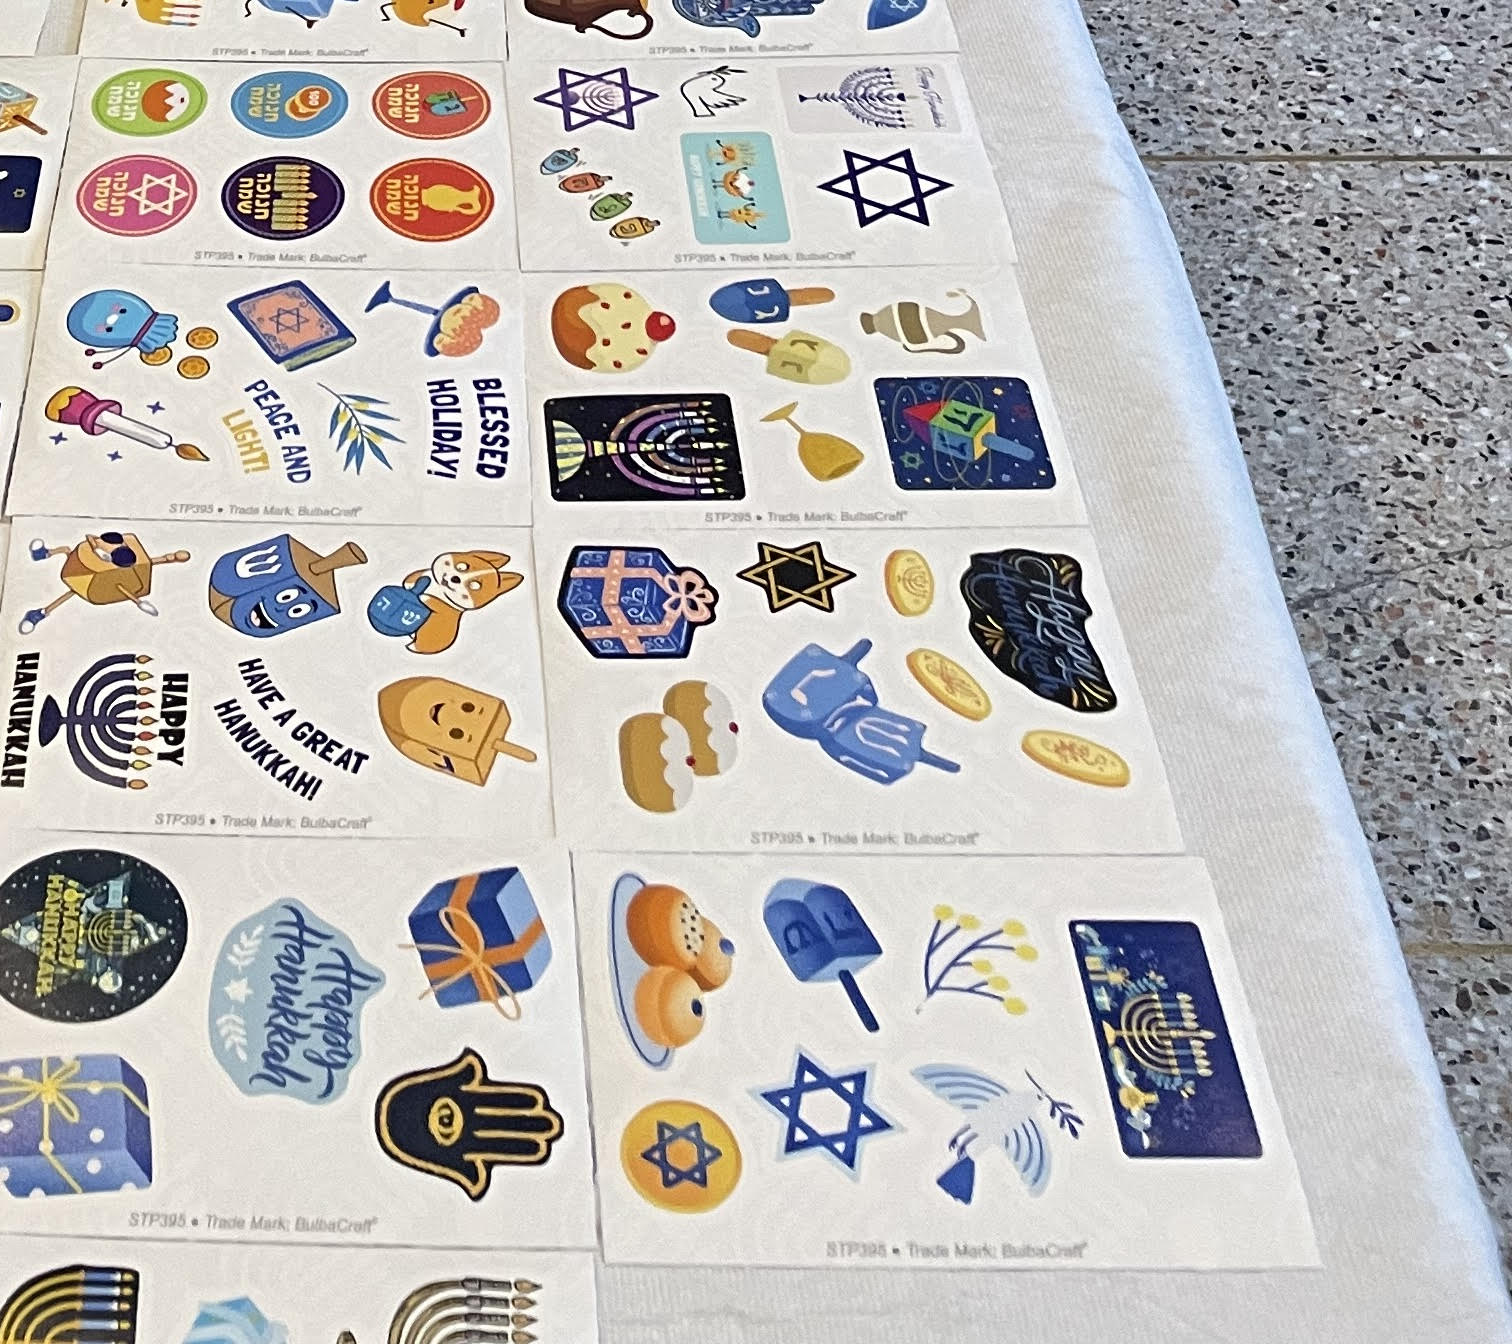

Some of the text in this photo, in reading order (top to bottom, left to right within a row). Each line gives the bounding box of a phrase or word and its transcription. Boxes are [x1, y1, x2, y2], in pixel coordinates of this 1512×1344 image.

[107, 85, 124, 118] שמח
[123, 81, 142, 122] חנוכה
[248, 86, 265, 118] שמח
[264, 82, 282, 123] חנוכה
[388, 87, 403, 119] שמח
[404, 83, 419, 123] חנוכה
[93, 176, 111, 212] שמח
[109, 171, 129, 217] חנוכה
[237, 177, 254, 215] שמח
[254, 173, 272, 220] חנוכה
[386, 178, 401, 215] שמח
[403, 174, 419, 222] חנוכה
[222, 409, 269, 473] LIGHT!
[245, 379, 311, 483] PEACE AND
[427, 379, 462, 479] HOLIDAY!
[473, 378, 510, 479] BLESSED
[229, 505, 260, 516] Trade
[767, 512, 800, 523] Trade
[1014, 555, 1102, 682] Happy
[0, 652, 40, 787] HANUKKAH
[157, 673, 188, 766] HAPPY
[239, 658, 369, 774] HAVE A GREAT
[214, 698, 323, 801] HANUKKAH!
[154, 813, 206, 827] STP395
[222, 815, 257, 828] Trade
[750, 831, 804, 846] STP395
[820, 831, 858, 846] Trade
[35, 874, 65, 998] HANUKKAH
[57, 906, 81, 970] HAPPY
[249, 905, 334, 1089] Hanukkah
[303, 948, 381, 1100] Happy
[127, 1212, 186, 1229] STP395
[205, 1214, 246, 1231] Trade
[826, 1241, 888, 1259] STP395
[906, 1241, 949, 1258] Trade
